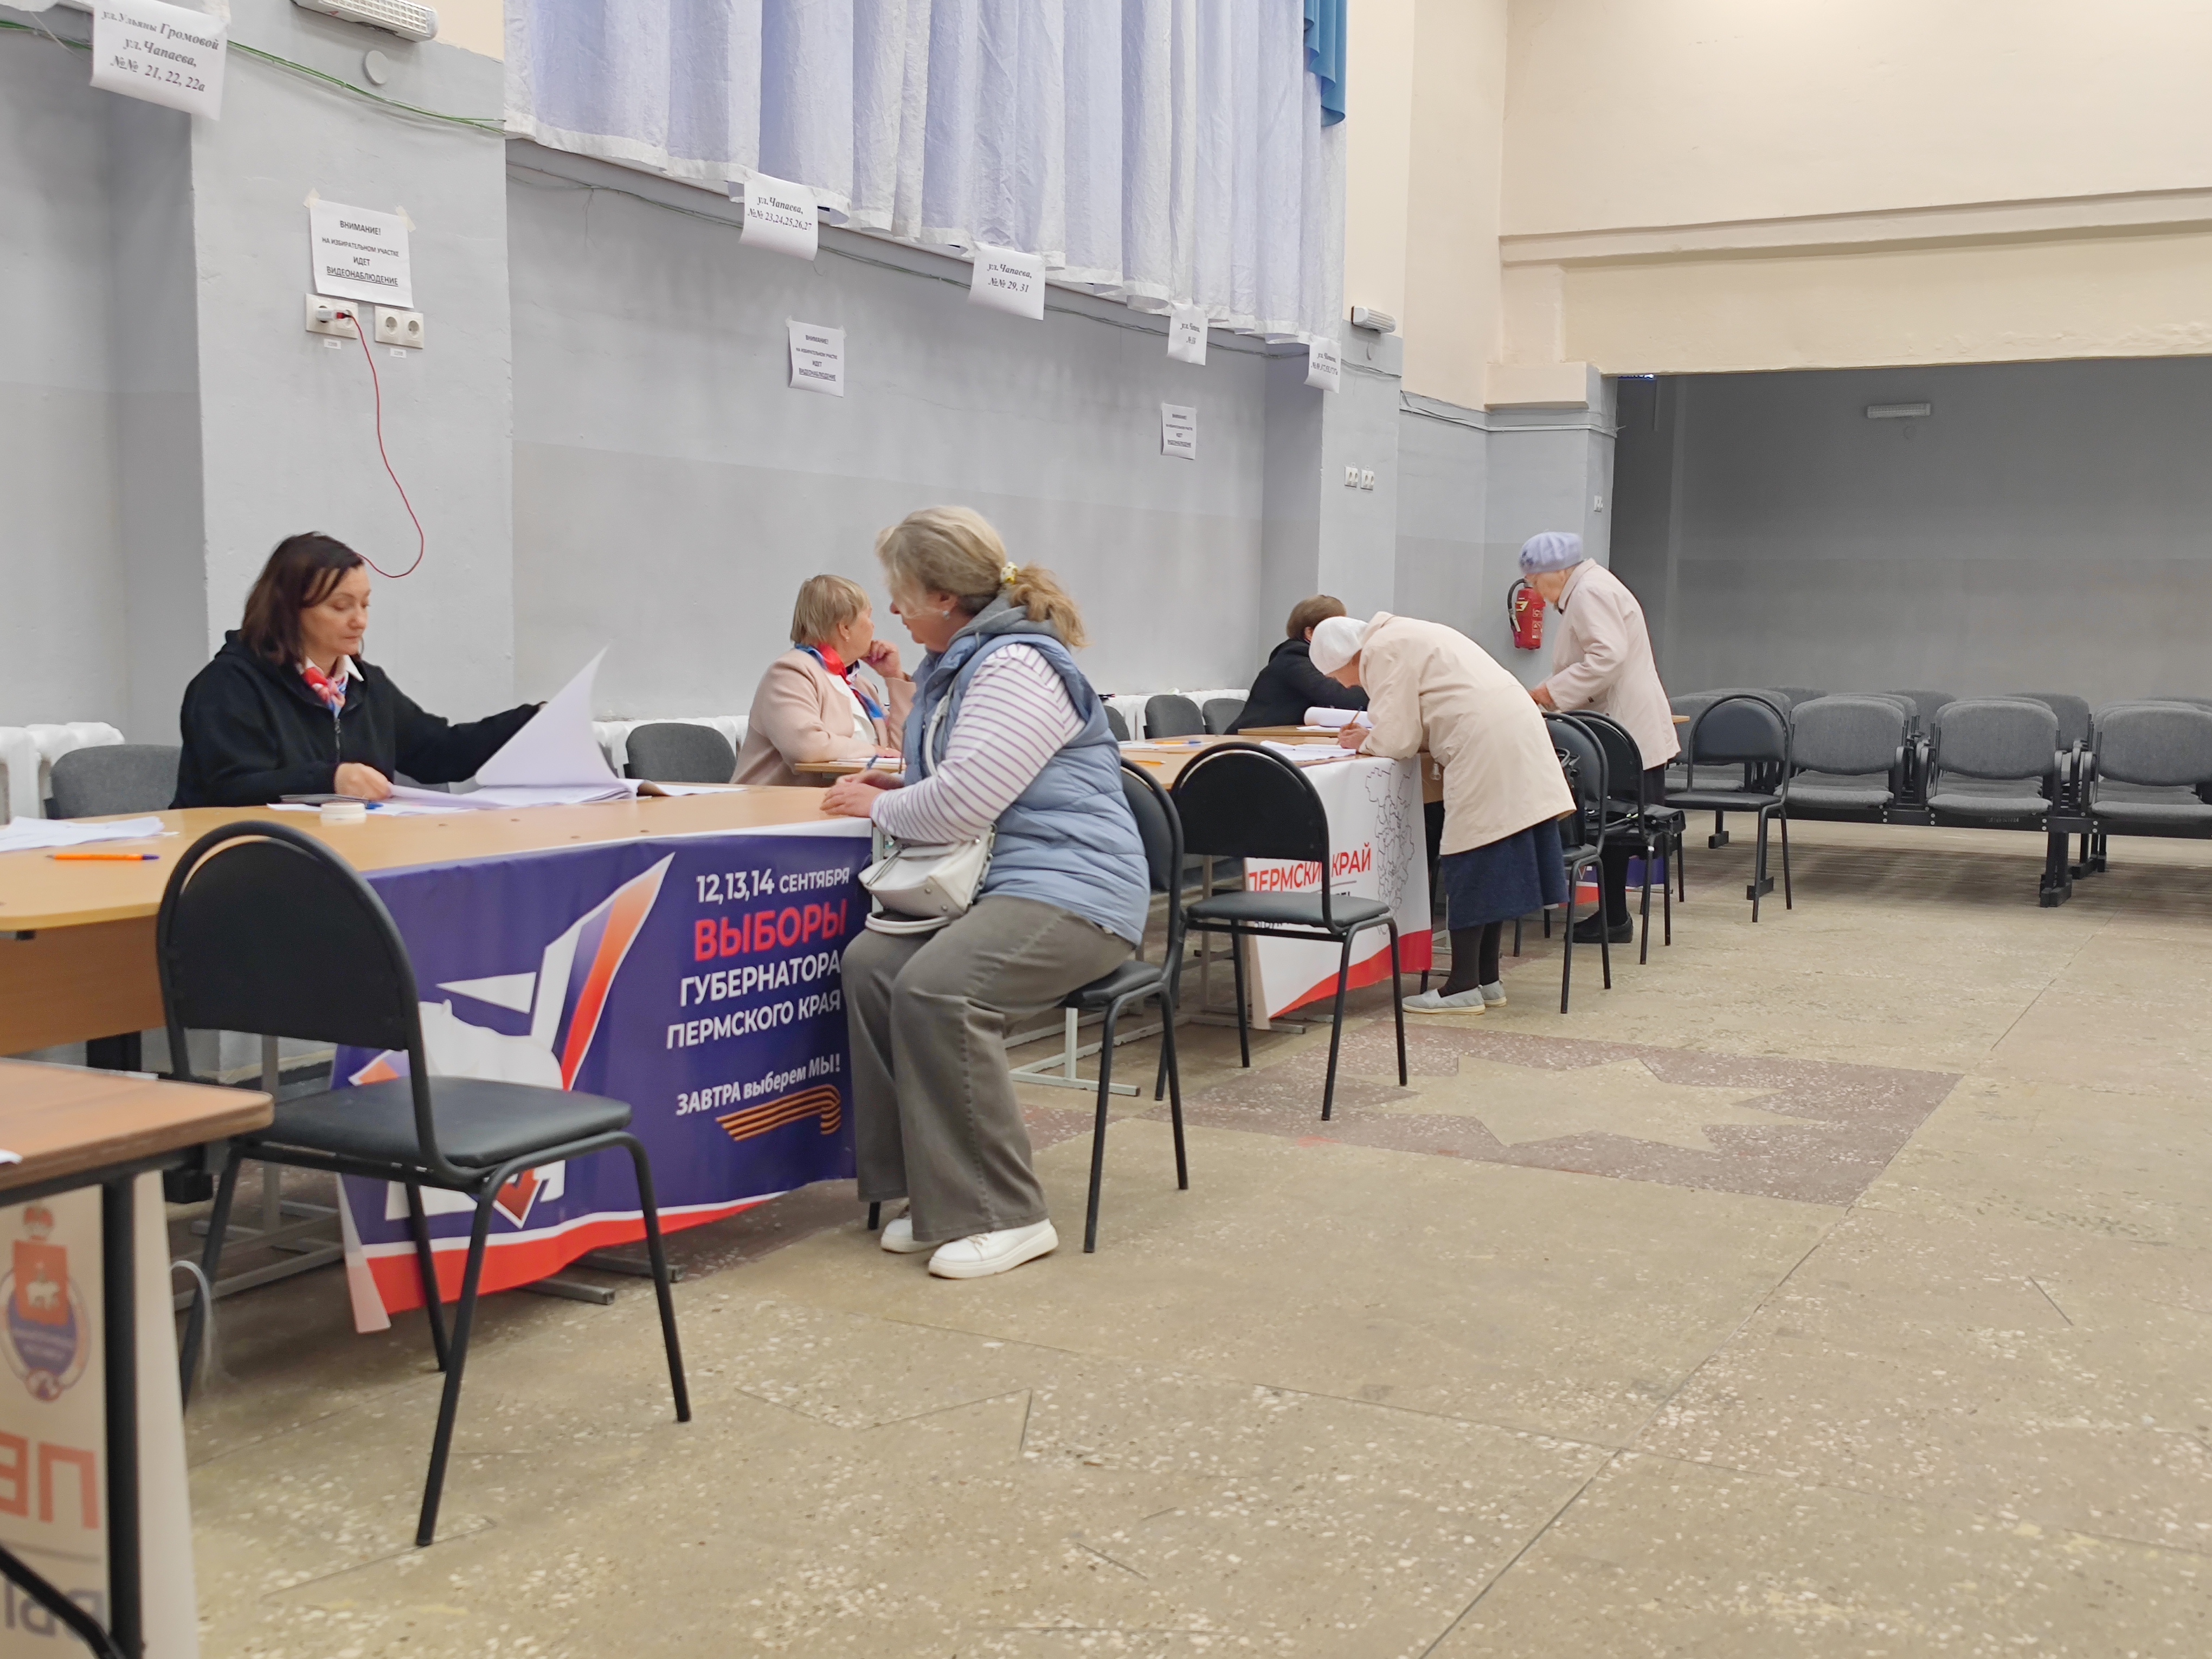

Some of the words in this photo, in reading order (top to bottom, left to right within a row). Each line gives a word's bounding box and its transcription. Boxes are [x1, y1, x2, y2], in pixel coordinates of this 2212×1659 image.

[160, 23, 220, 50] Громовой
[165, 70, 182, 87] 22,
[185, 76, 205, 92] 22а
[340, 220, 381, 235] ВНИМАНИЕ!
[331, 239, 376, 252] ИЗБИРАТЕЛЬНОМ
[377, 248, 399, 257] УЧАСТКЕ
[353, 256, 370, 266] ИДЕТ
[326, 266, 398, 286] ВИДЕОНАБЛЮДЕНИЕ
[1020, 284, 1029, 292] 31
[1249, 861, 1323, 892] ПЕРМСКИ
[1332, 842, 1371, 877] КРАЙ
[696, 867, 775, 905] 12,13,14
[779, 867, 850, 893] СЕНТЯБРЯ
[695, 898, 848, 961] ВЫБОРЫ
[680, 950, 841, 1007] ГУБЕРНАТОРА
[666, 1001, 794, 1050] ПЕРМСКОГО
[798, 989, 841, 1021] КРАЯ
[676, 1082, 741, 1116] ЗАВТРА
[743, 1065, 806, 1099] выберем
